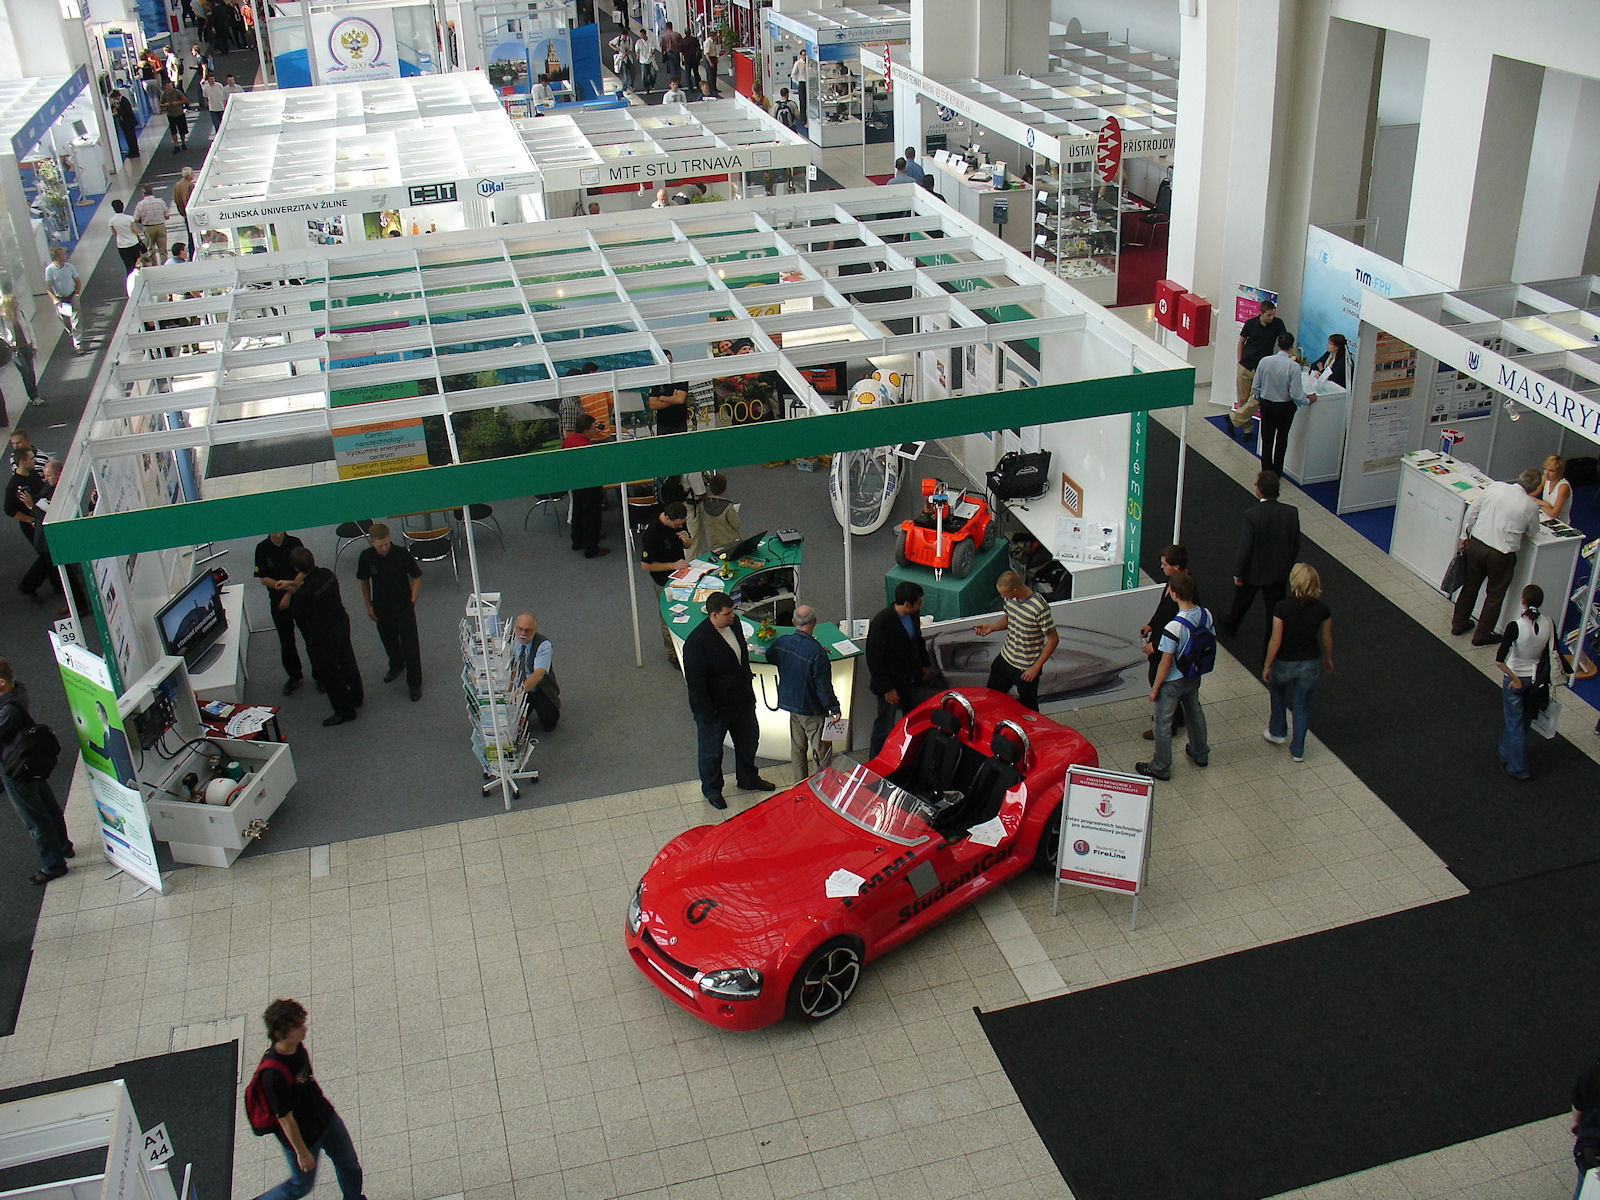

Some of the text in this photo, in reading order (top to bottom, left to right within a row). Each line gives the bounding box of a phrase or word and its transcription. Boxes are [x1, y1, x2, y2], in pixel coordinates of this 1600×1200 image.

[1068, 144, 1096, 158] ÚSTAV
[609, 166, 641, 181] MTF
[646, 161, 677, 177] STU
[681, 155, 743, 173] TRNAVA
[410, 183, 455, 202] CEIT
[219, 209, 259, 220] ŽILINSKÁ
[261, 204, 312, 216] UNIVERZITA
[320, 199, 348, 210] ŽILINE
[719, 399, 764, 425] 000
[365, 430, 393, 439] Centrum
[369, 453, 395, 461] centrum
[351, 462, 379, 471] Centrum
[1127, 498, 1142, 521] 3D
[59, 621, 73, 632] A1
[62, 632, 76, 643] 39
[1093, 849, 1127, 859] FireLine
[898, 843, 1016, 924] StudentCar
[144, 1129, 164, 1149] A1
[149, 1143, 169, 1161] 44
